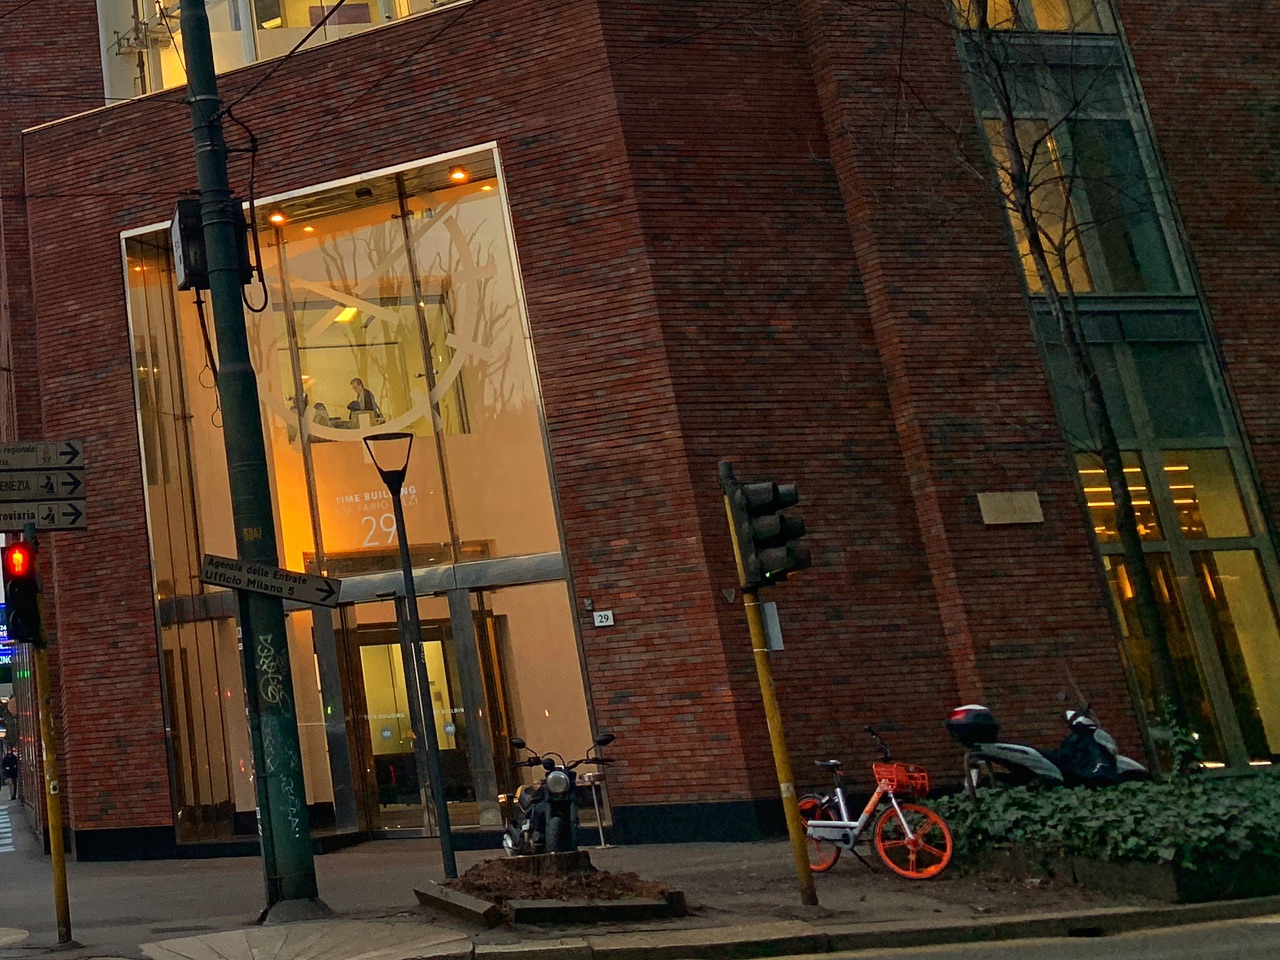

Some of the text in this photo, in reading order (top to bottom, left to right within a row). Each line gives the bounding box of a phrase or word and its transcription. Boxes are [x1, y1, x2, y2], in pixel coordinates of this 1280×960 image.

[3, 444, 35, 454] regionale
[336, 486, 416, 504] TIME BUILNG
[361, 513, 396, 547] 29
[205, 569, 295, 595] Ufficio Milano 5
[208, 558, 307, 585] Agenzia delle Entrate
[598, 614, 609, 623] 29
